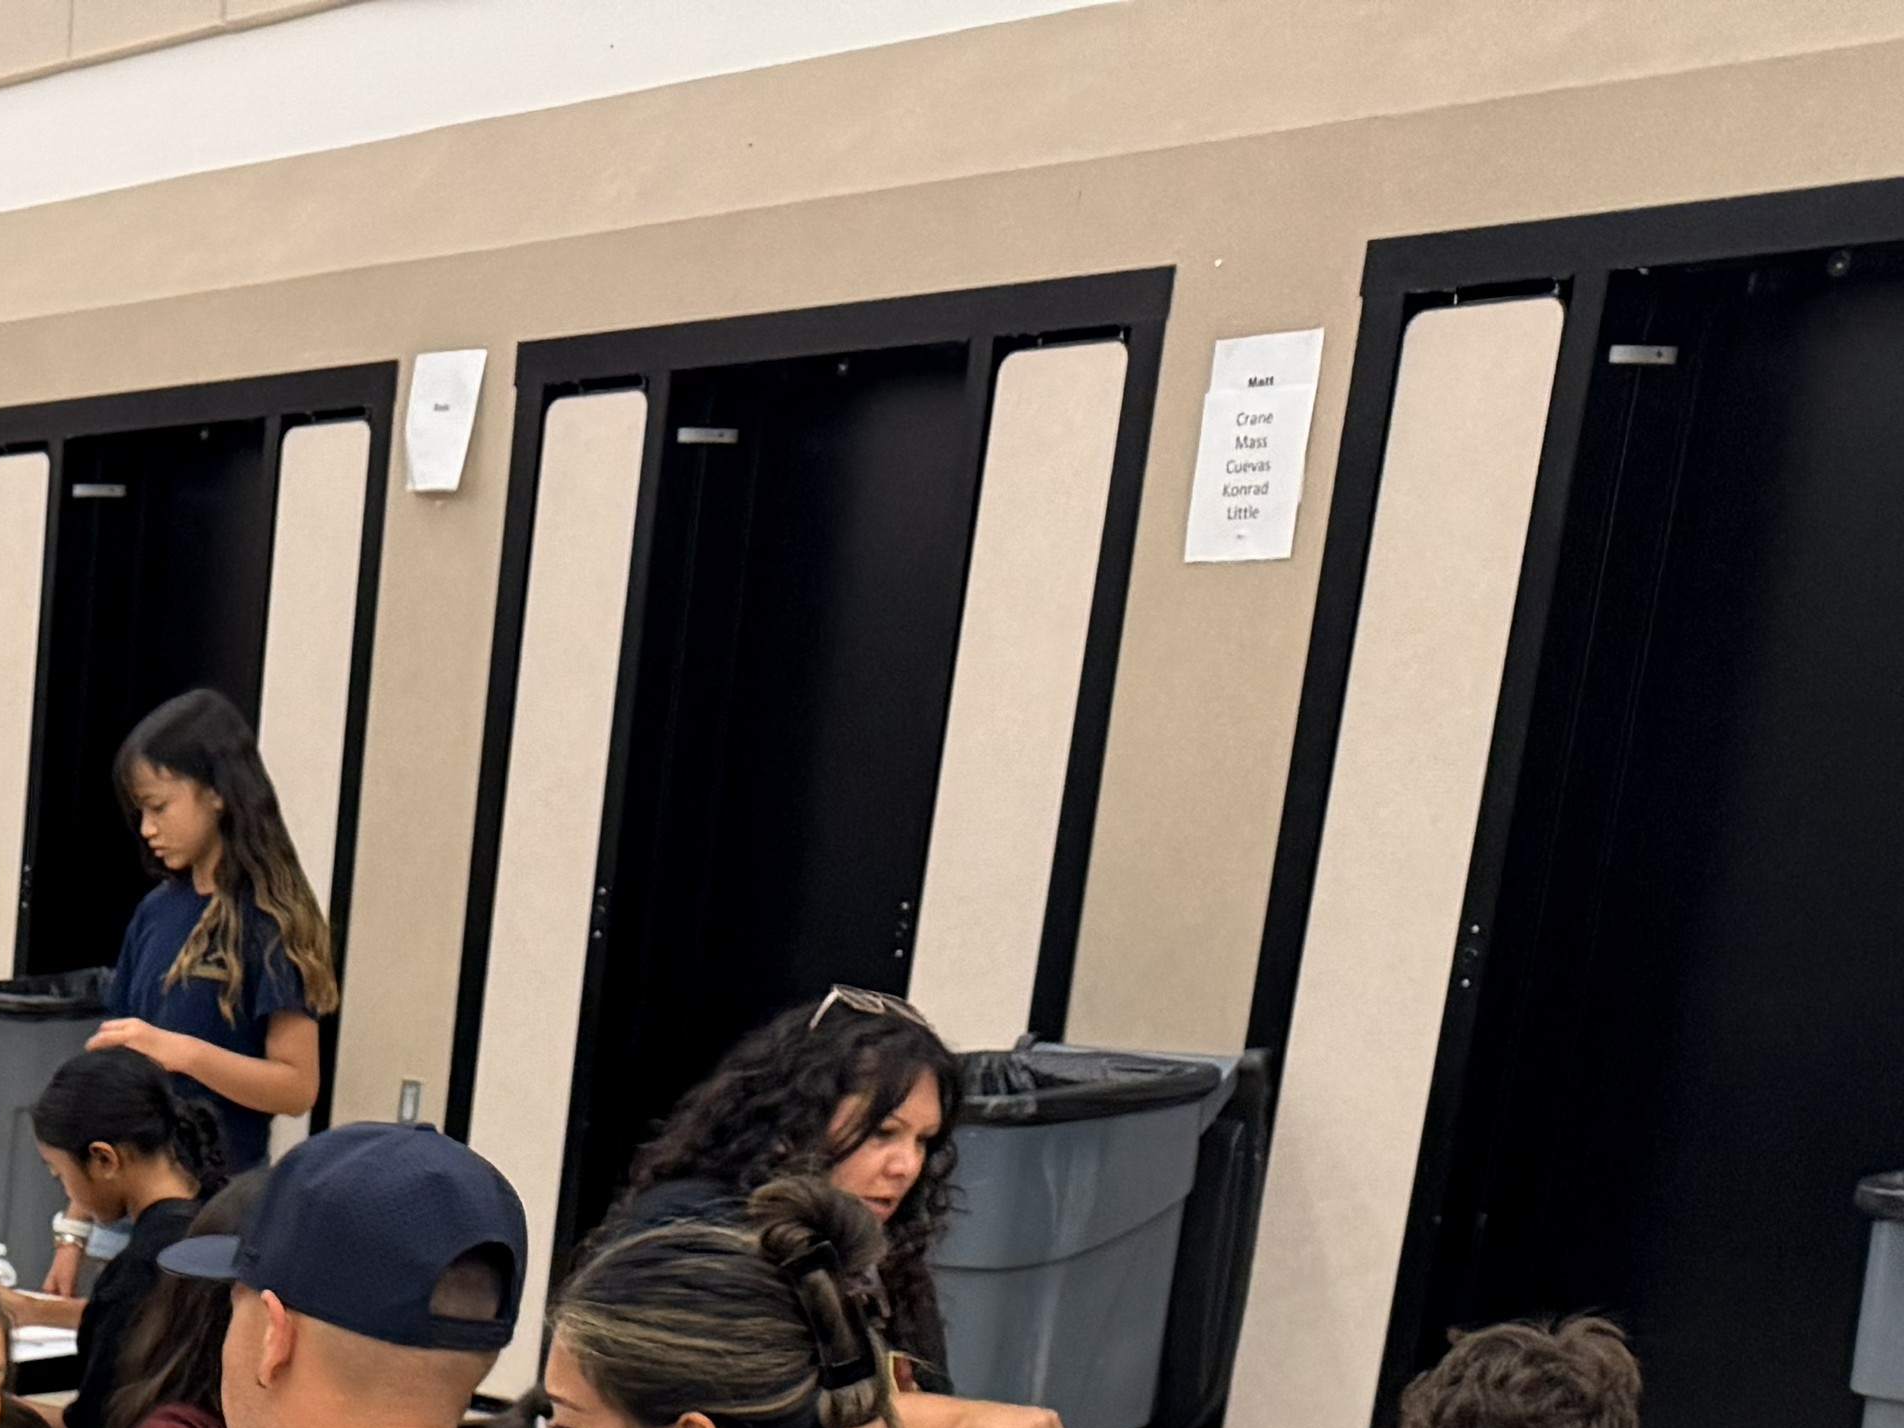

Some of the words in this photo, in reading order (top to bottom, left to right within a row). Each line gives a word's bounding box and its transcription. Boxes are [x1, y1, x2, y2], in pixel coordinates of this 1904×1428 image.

[1235, 412, 1274, 427] Crane
[1234, 435, 1268, 450] Mass
[1225, 459, 1272, 475] Cuevas
[1222, 480, 1270, 498] Konrad
[1226, 505, 1261, 521] Little
